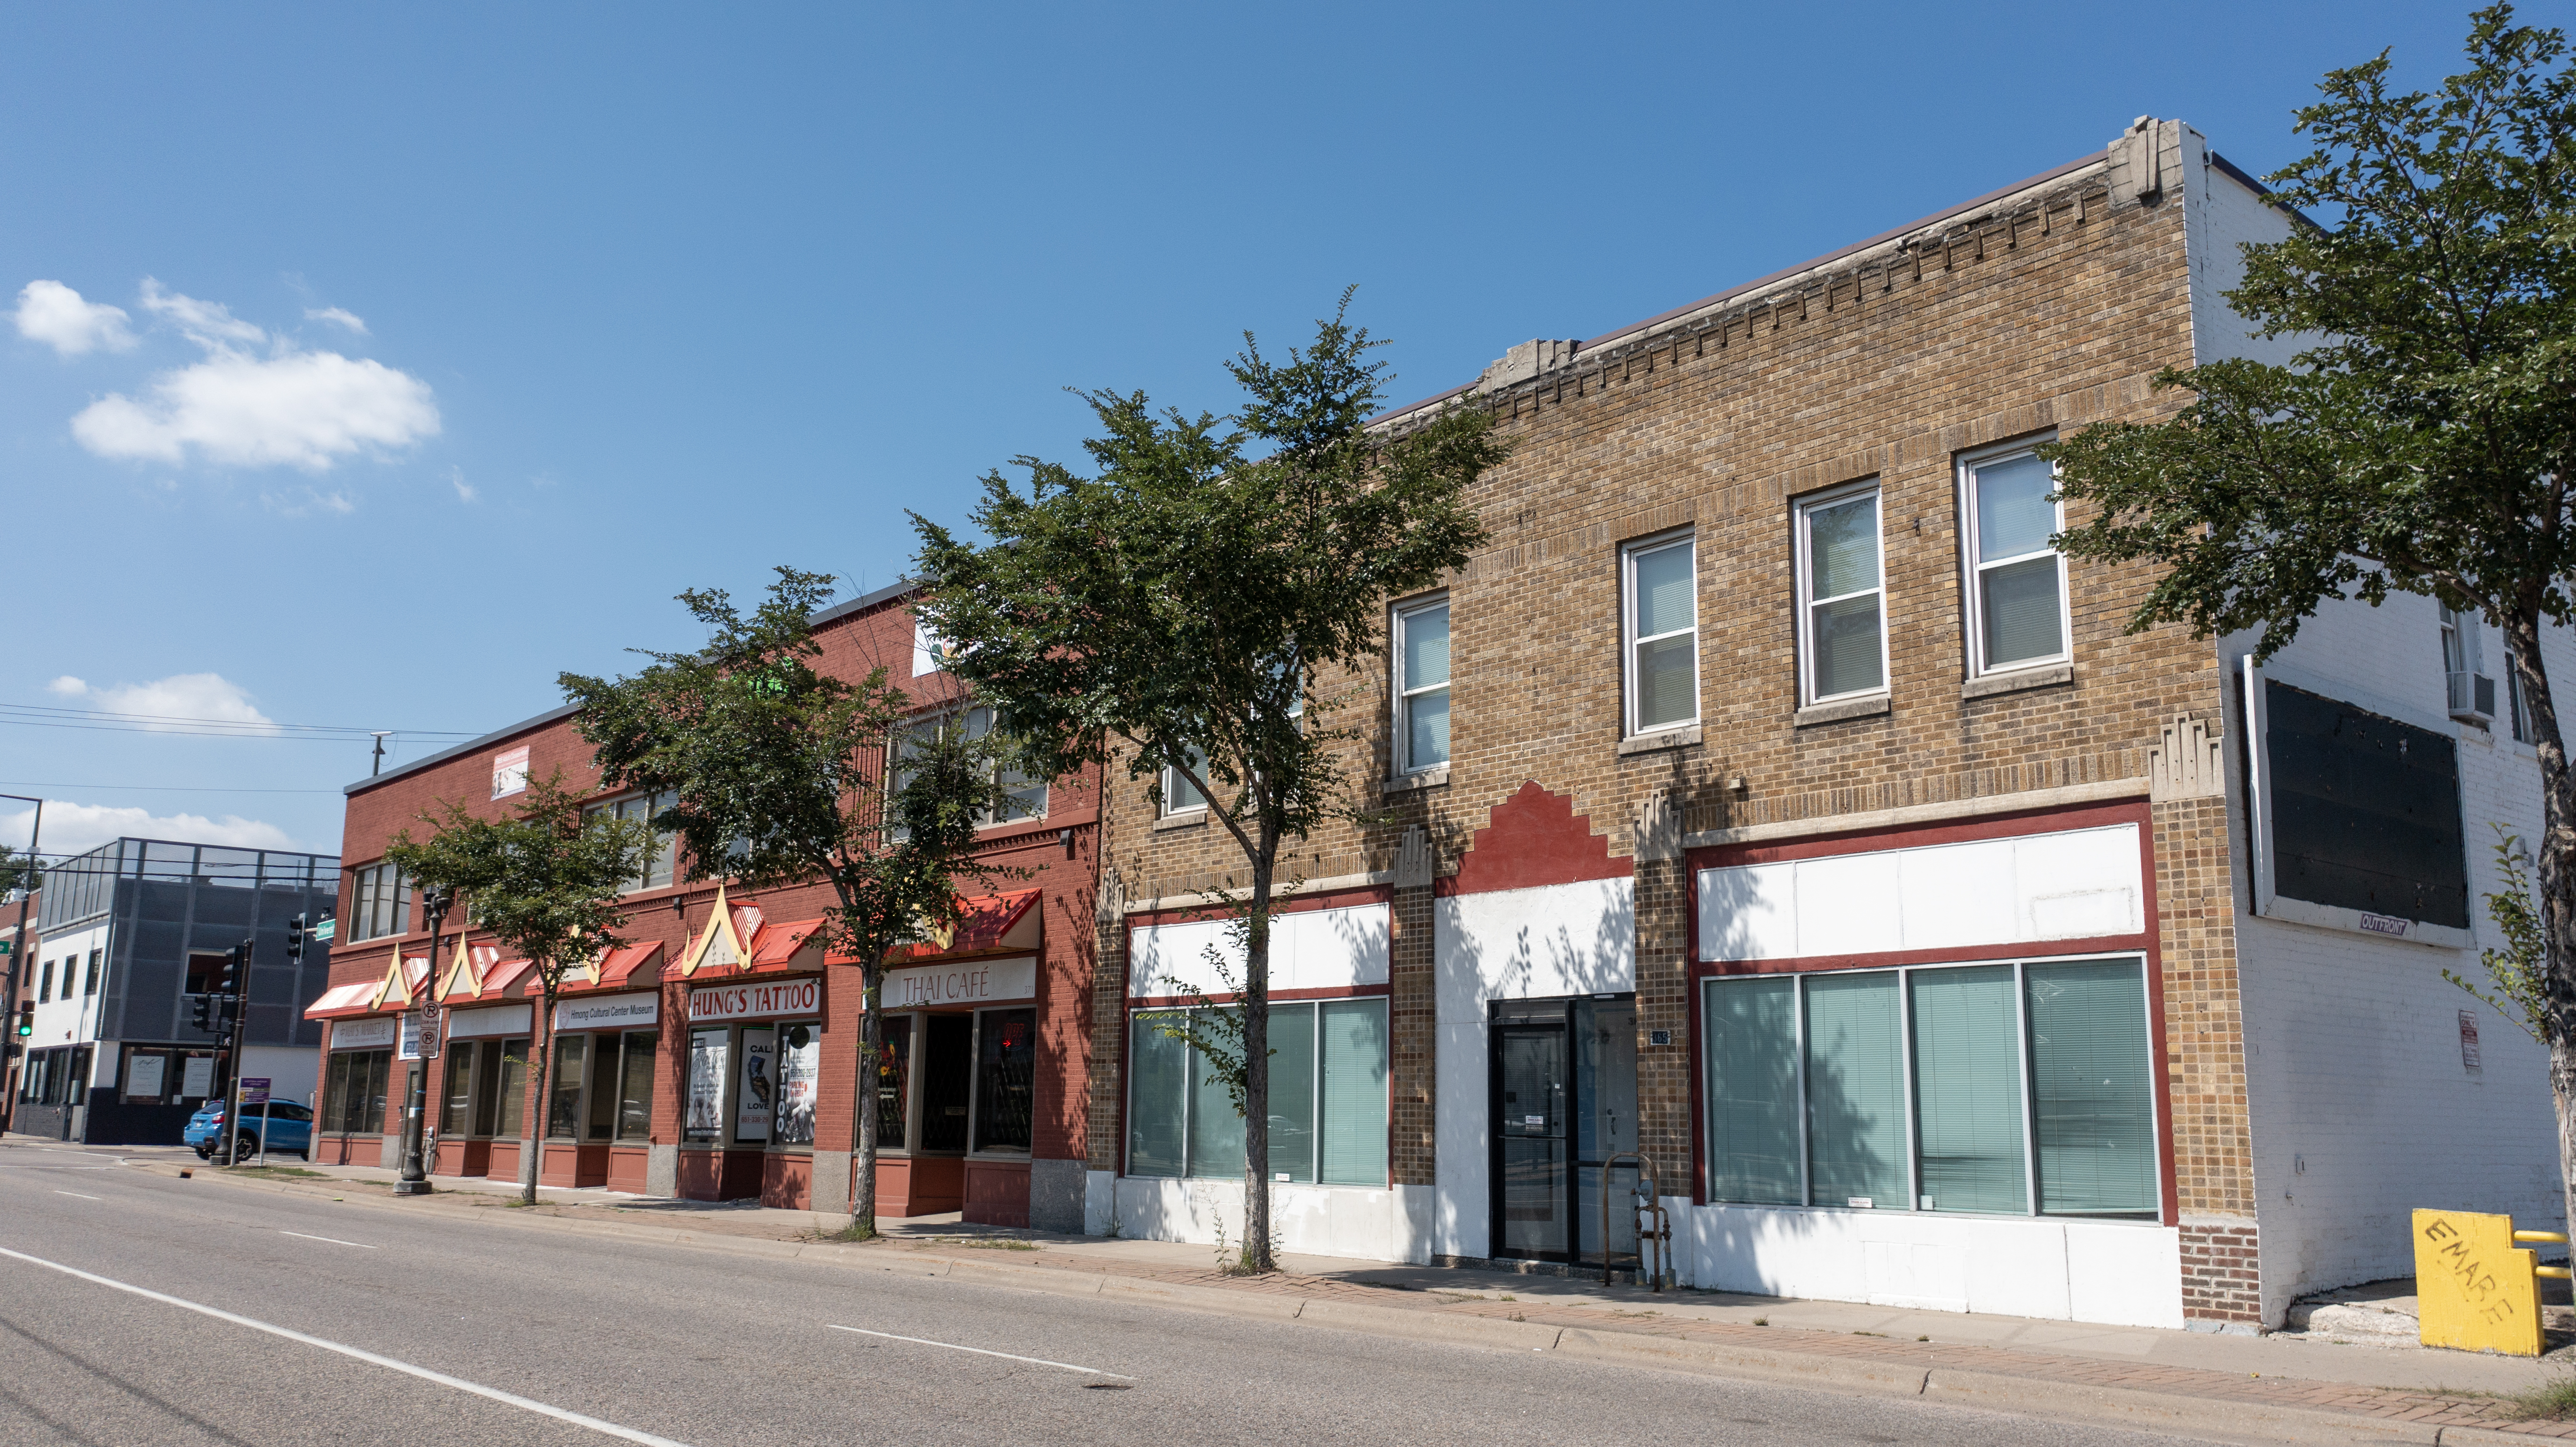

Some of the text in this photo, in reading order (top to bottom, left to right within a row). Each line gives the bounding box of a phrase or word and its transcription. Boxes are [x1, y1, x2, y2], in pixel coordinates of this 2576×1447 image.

[2362, 914, 2405, 934] OUTFRONT
[903, 966, 989, 1002] THAI CAFÉ
[1024, 986, 1034, 994] 371
[693, 983, 815, 1016] HUNG'S TATTOO
[571, 1004, 653, 1020] Hmong Cultural Center Museum
[361, 1022, 381, 1035] MARKET
[2461, 1019, 2475, 1027] ONLY
[1653, 1033, 1667, 1042] 365
[790, 1068, 816, 1077] 651-330-2937
[776, 1036, 789, 1133] TATTOO
